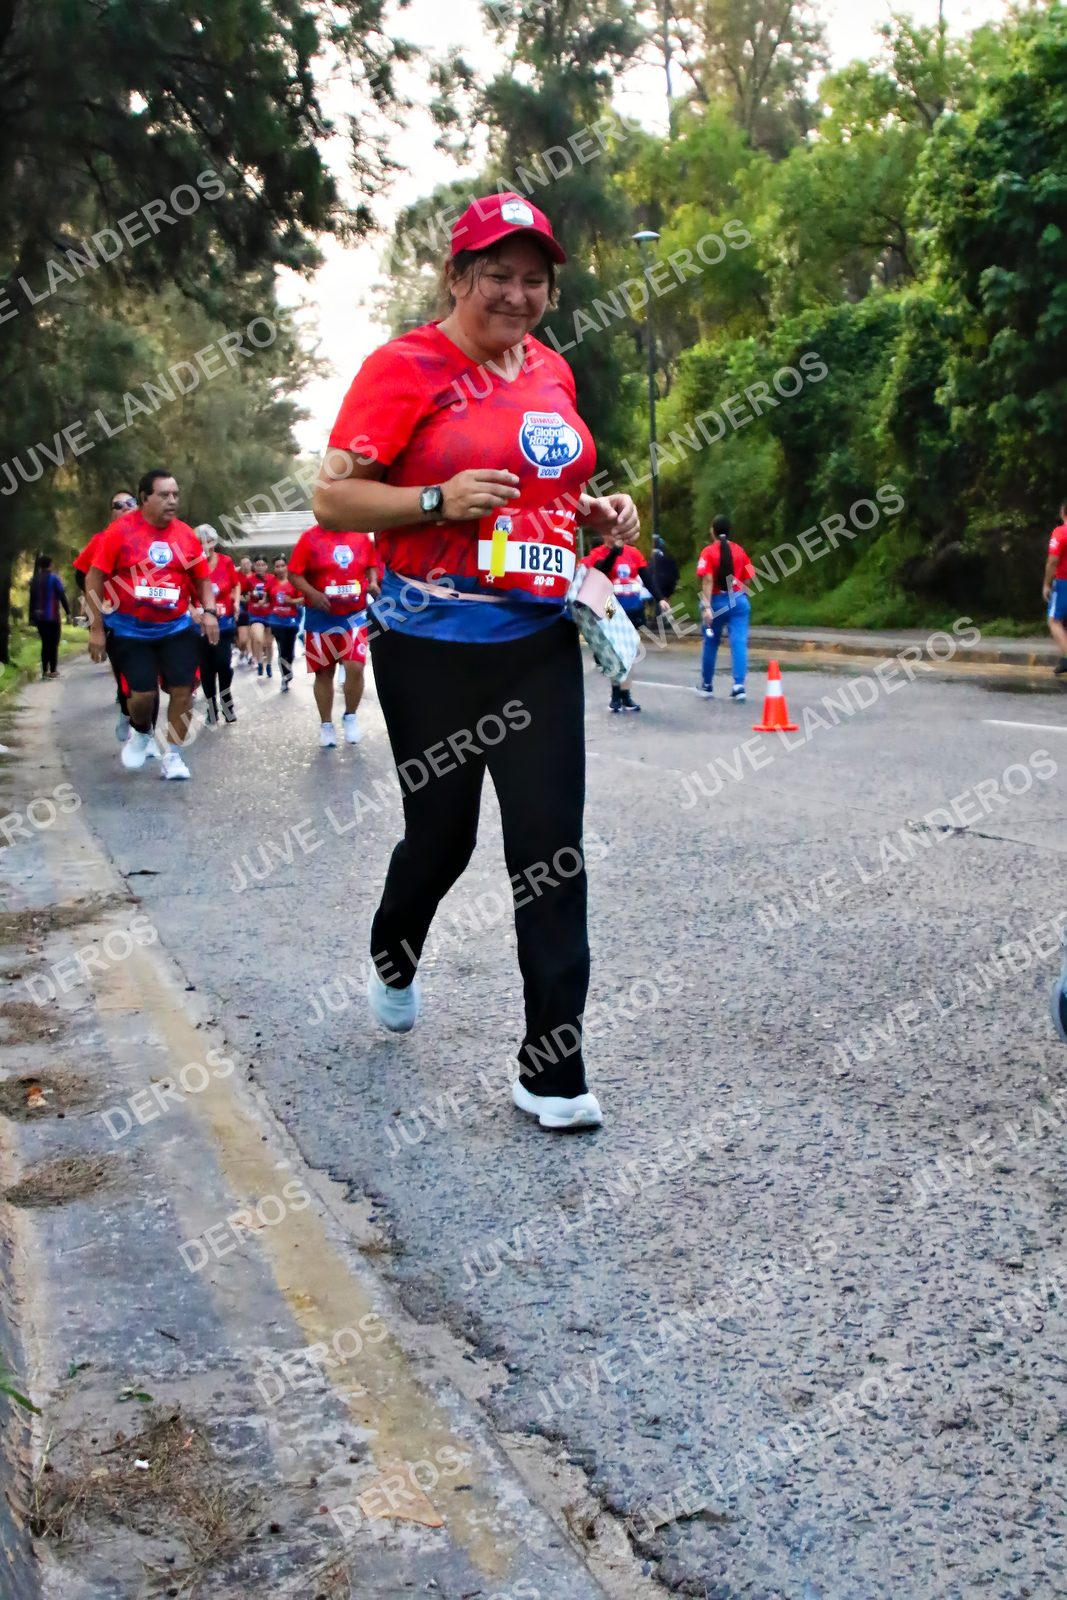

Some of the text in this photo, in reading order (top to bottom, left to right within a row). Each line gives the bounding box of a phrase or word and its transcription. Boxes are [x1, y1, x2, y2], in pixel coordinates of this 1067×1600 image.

[534, 426, 564, 437] Global
[529, 436, 555, 446] Race
[539, 468, 560, 477] 2026
[519, 544, 563, 574] 1829
